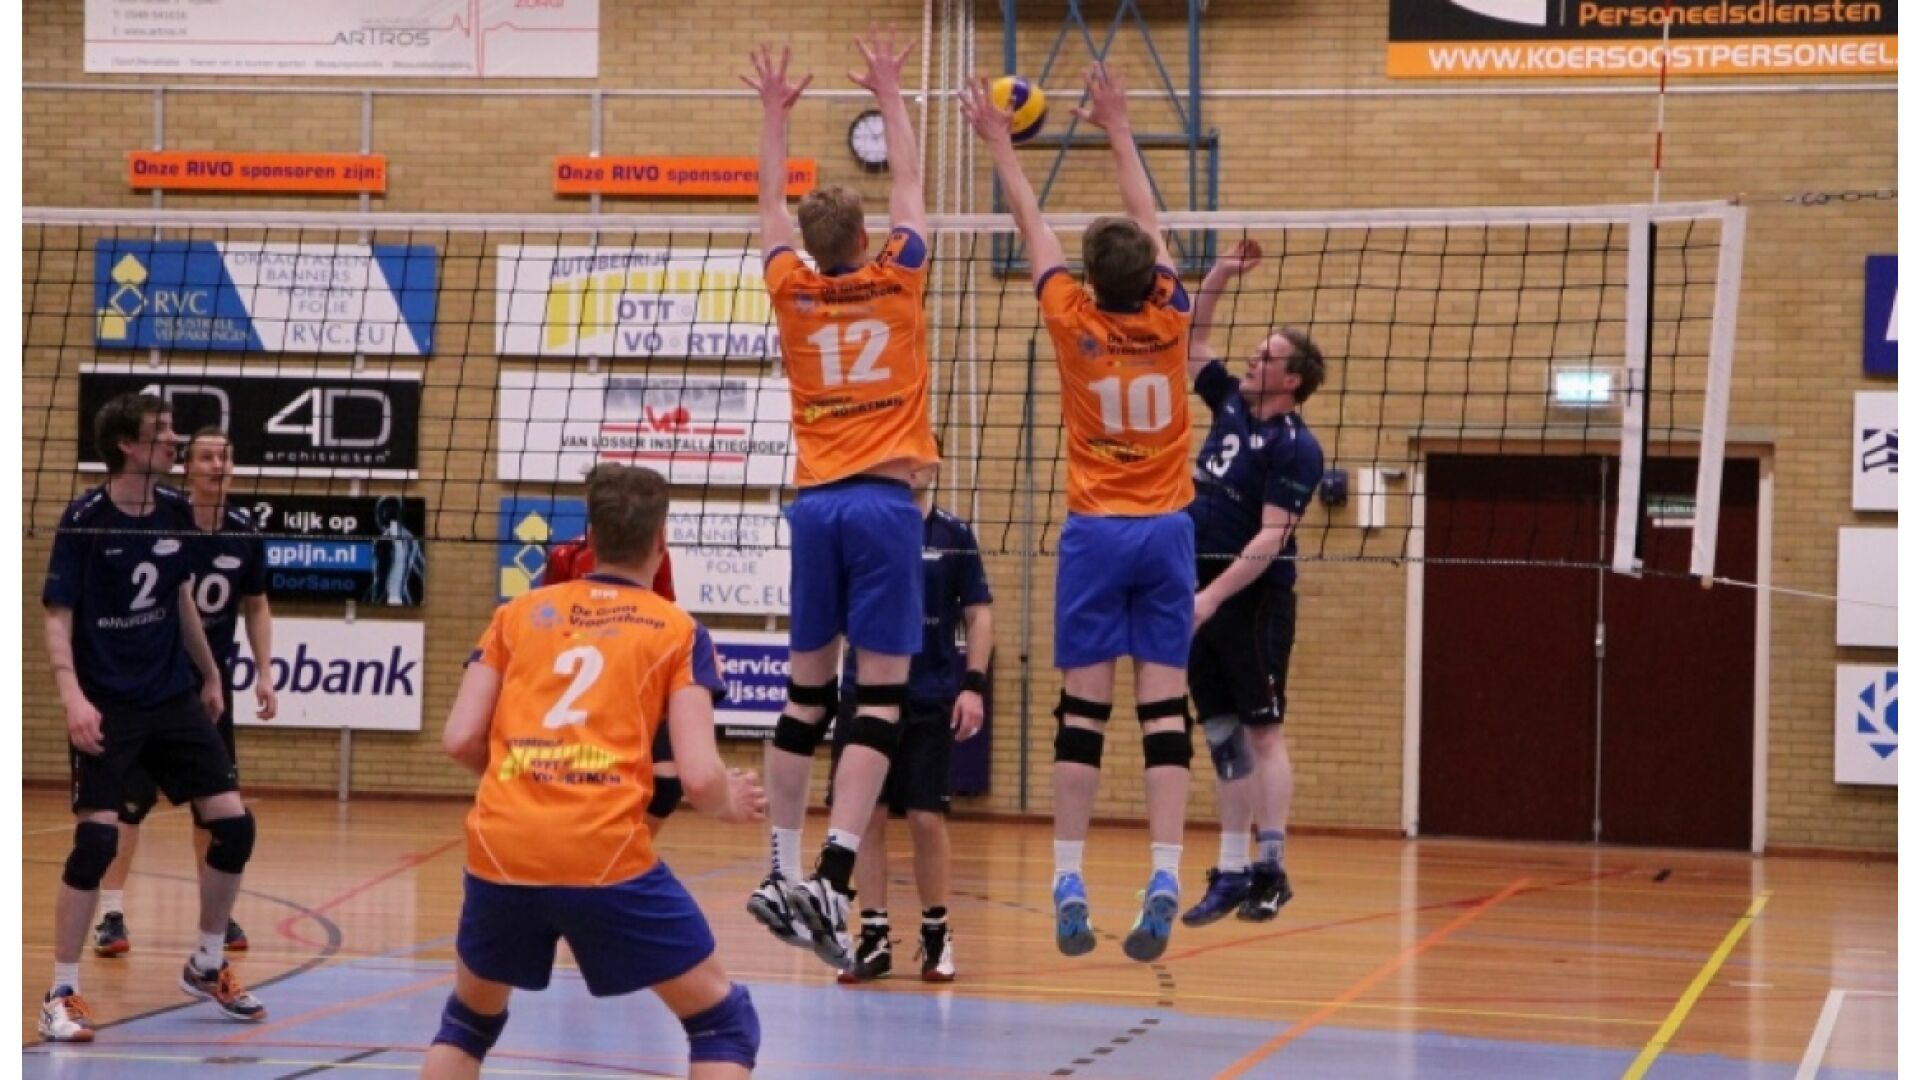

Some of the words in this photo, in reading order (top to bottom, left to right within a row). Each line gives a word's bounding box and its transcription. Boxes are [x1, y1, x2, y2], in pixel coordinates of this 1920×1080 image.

[1578, 0, 1881, 27] Personeelsdiensten
[333, 27, 431, 47] ARTROS
[133, 158, 180, 177] Onze
[186, 160, 234, 178] RIVO
[240, 163, 336, 181] sponsoren
[343, 165, 383, 183] zijn:
[557, 164, 604, 181] Onze
[612, 165, 660, 182] RIVO
[266, 268, 351, 283] BANNERS
[155, 290, 208, 315] RVC
[298, 300, 348, 314] FOLIE
[293, 323, 385, 346] RVC.EU
[807, 318, 892, 387] 12
[1087, 372, 1173, 434] 10
[266, 387, 392, 448] 4D
[561, 435, 588, 448] VAN
[591, 436, 645, 450] LOSSER
[649, 437, 788, 455] INSTALLATIEGROEP
[1205, 433, 1241, 478] 3
[328, 516, 359, 534] op
[266, 543, 357, 567] gpijn.nl
[705, 560, 759, 574] FOLIE
[129, 561, 159, 612] 2
[570, 602, 593, 616] De
[230, 643, 417, 696] bobank
[541, 645, 605, 731] 2
